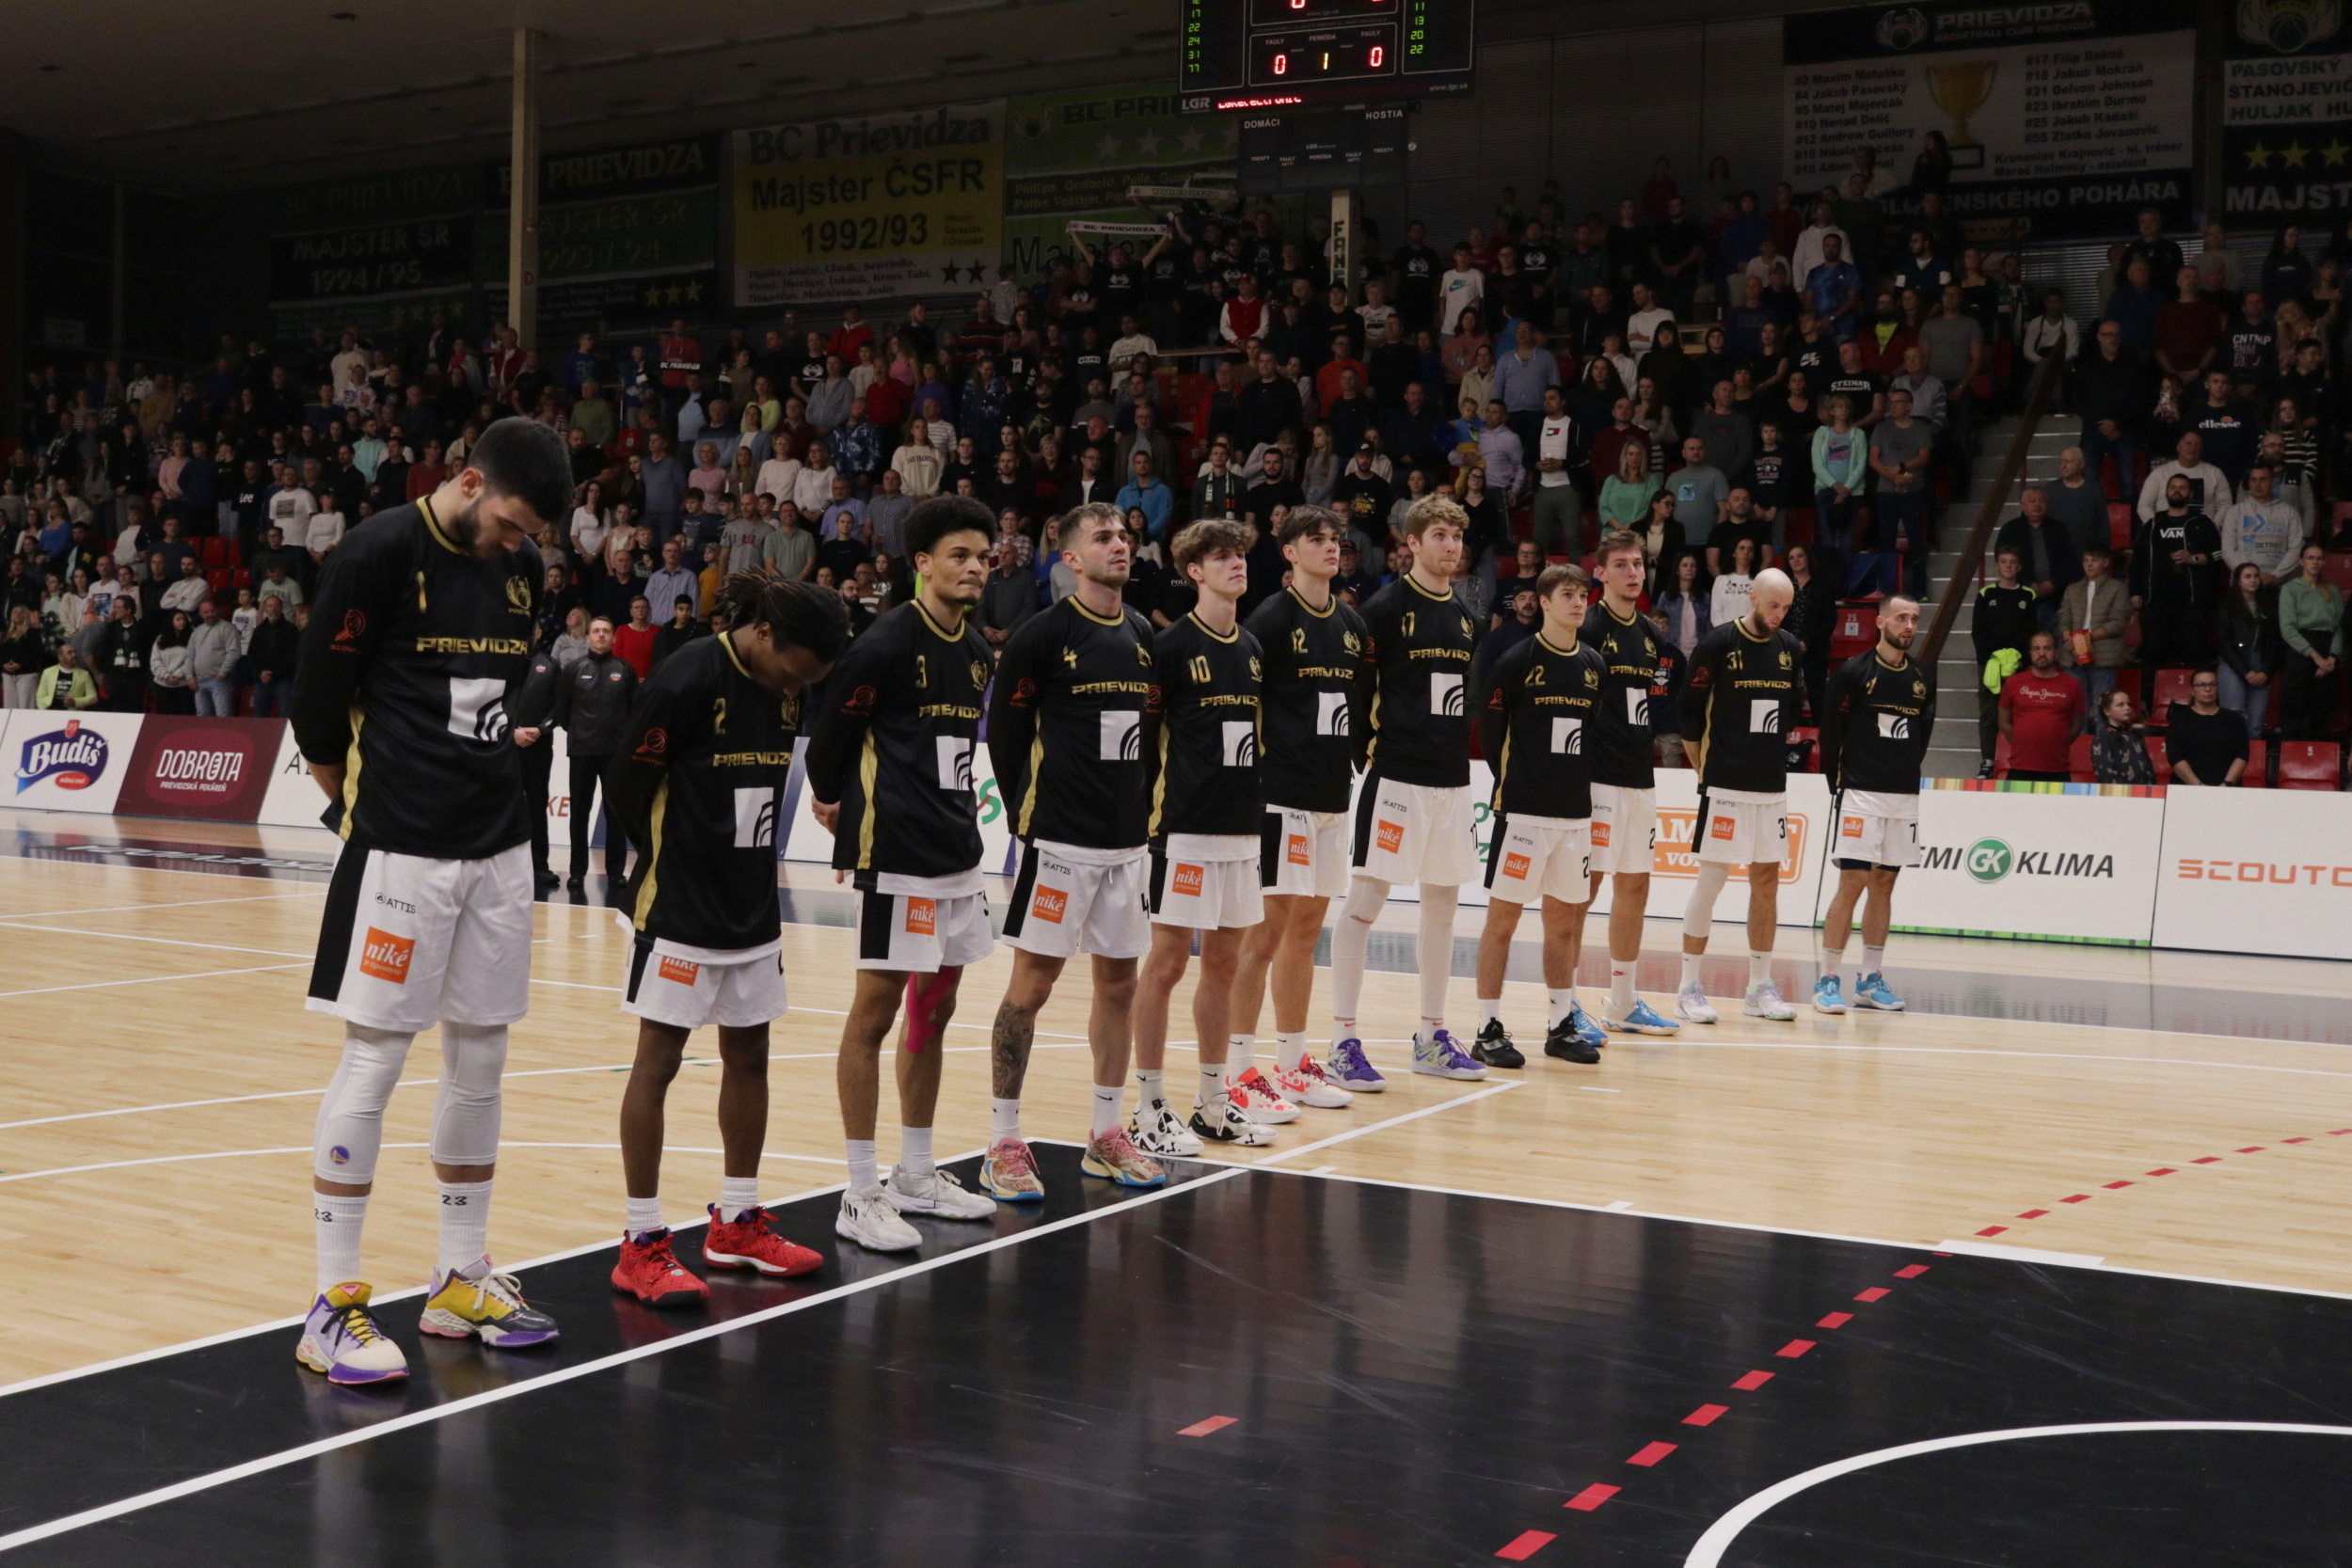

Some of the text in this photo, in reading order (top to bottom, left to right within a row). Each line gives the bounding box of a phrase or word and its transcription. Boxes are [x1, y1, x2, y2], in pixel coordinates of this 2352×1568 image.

[1414, 15, 1424, 25] 13
[1936, 2, 2091, 29] PRIEVIDZA
[1188, 23, 1200, 33] 22
[1410, 30, 1424, 40] 20
[1188, 37, 1200, 46] 24
[1409, 44, 1423, 55] 22
[1274, 46, 1383, 75] 0 1 0
[2232, 56, 2341, 78] PASOVSKÝ
[1182, 97, 1210, 111] LGR
[2231, 103, 2312, 120] HULJAK
[1063, 102, 1106, 124] BC
[1244, 109, 1404, 129] DOMÁCI HOSTIA
[748, 125, 803, 165] BC
[816, 107, 991, 159] Prievidza
[548, 142, 705, 189] PRIEVIDZA
[752, 174, 874, 215] Majster
[884, 155, 985, 198] ČSFR
[2070, 181, 2180, 205] POHÁRA
[538, 204, 640, 236] AJSTER
[293, 223, 450, 261] MAJSTER SR
[801, 213, 929, 254] 1992/93
[1831, 379, 1871, 391] STEINAR
[2198, 420, 2241, 429] ellesse
[240, 493, 254, 503] Lee
[2159, 527, 2185, 539] VAN
[415, 637, 530, 656] PRIEVIDZA
[1291, 627, 1309, 654] 12
[1063, 645, 1078, 670] 4
[1726, 649, 1743, 671] 31
[914, 655, 927, 688] 3
[1188, 655, 1211, 685] 10
[1524, 664, 1546, 688] 22
[15, 735, 109, 777] Budiš
[2307, 746, 2313, 756] 5
[156, 750, 244, 782] DOBROTA
[1390, 801, 1407, 813] ATTIS
[1714, 821, 1733, 834] niké
[1844, 819, 1862, 832] niké
[1378, 827, 1401, 844] niké
[1518, 836, 1534, 846] ATTIS
[1050, 863, 1072, 876] ATTIS
[1506, 857, 1528, 872] niké
[1970, 847, 2114, 878] GK KLIMA
[1176, 871, 1202, 886] niké
[386, 897, 416, 914] ATTIS
[1036, 895, 1064, 912] niké
[910, 907, 934, 924] niké
[366, 940, 408, 968] niké
[442, 1195, 468, 1206] 23
